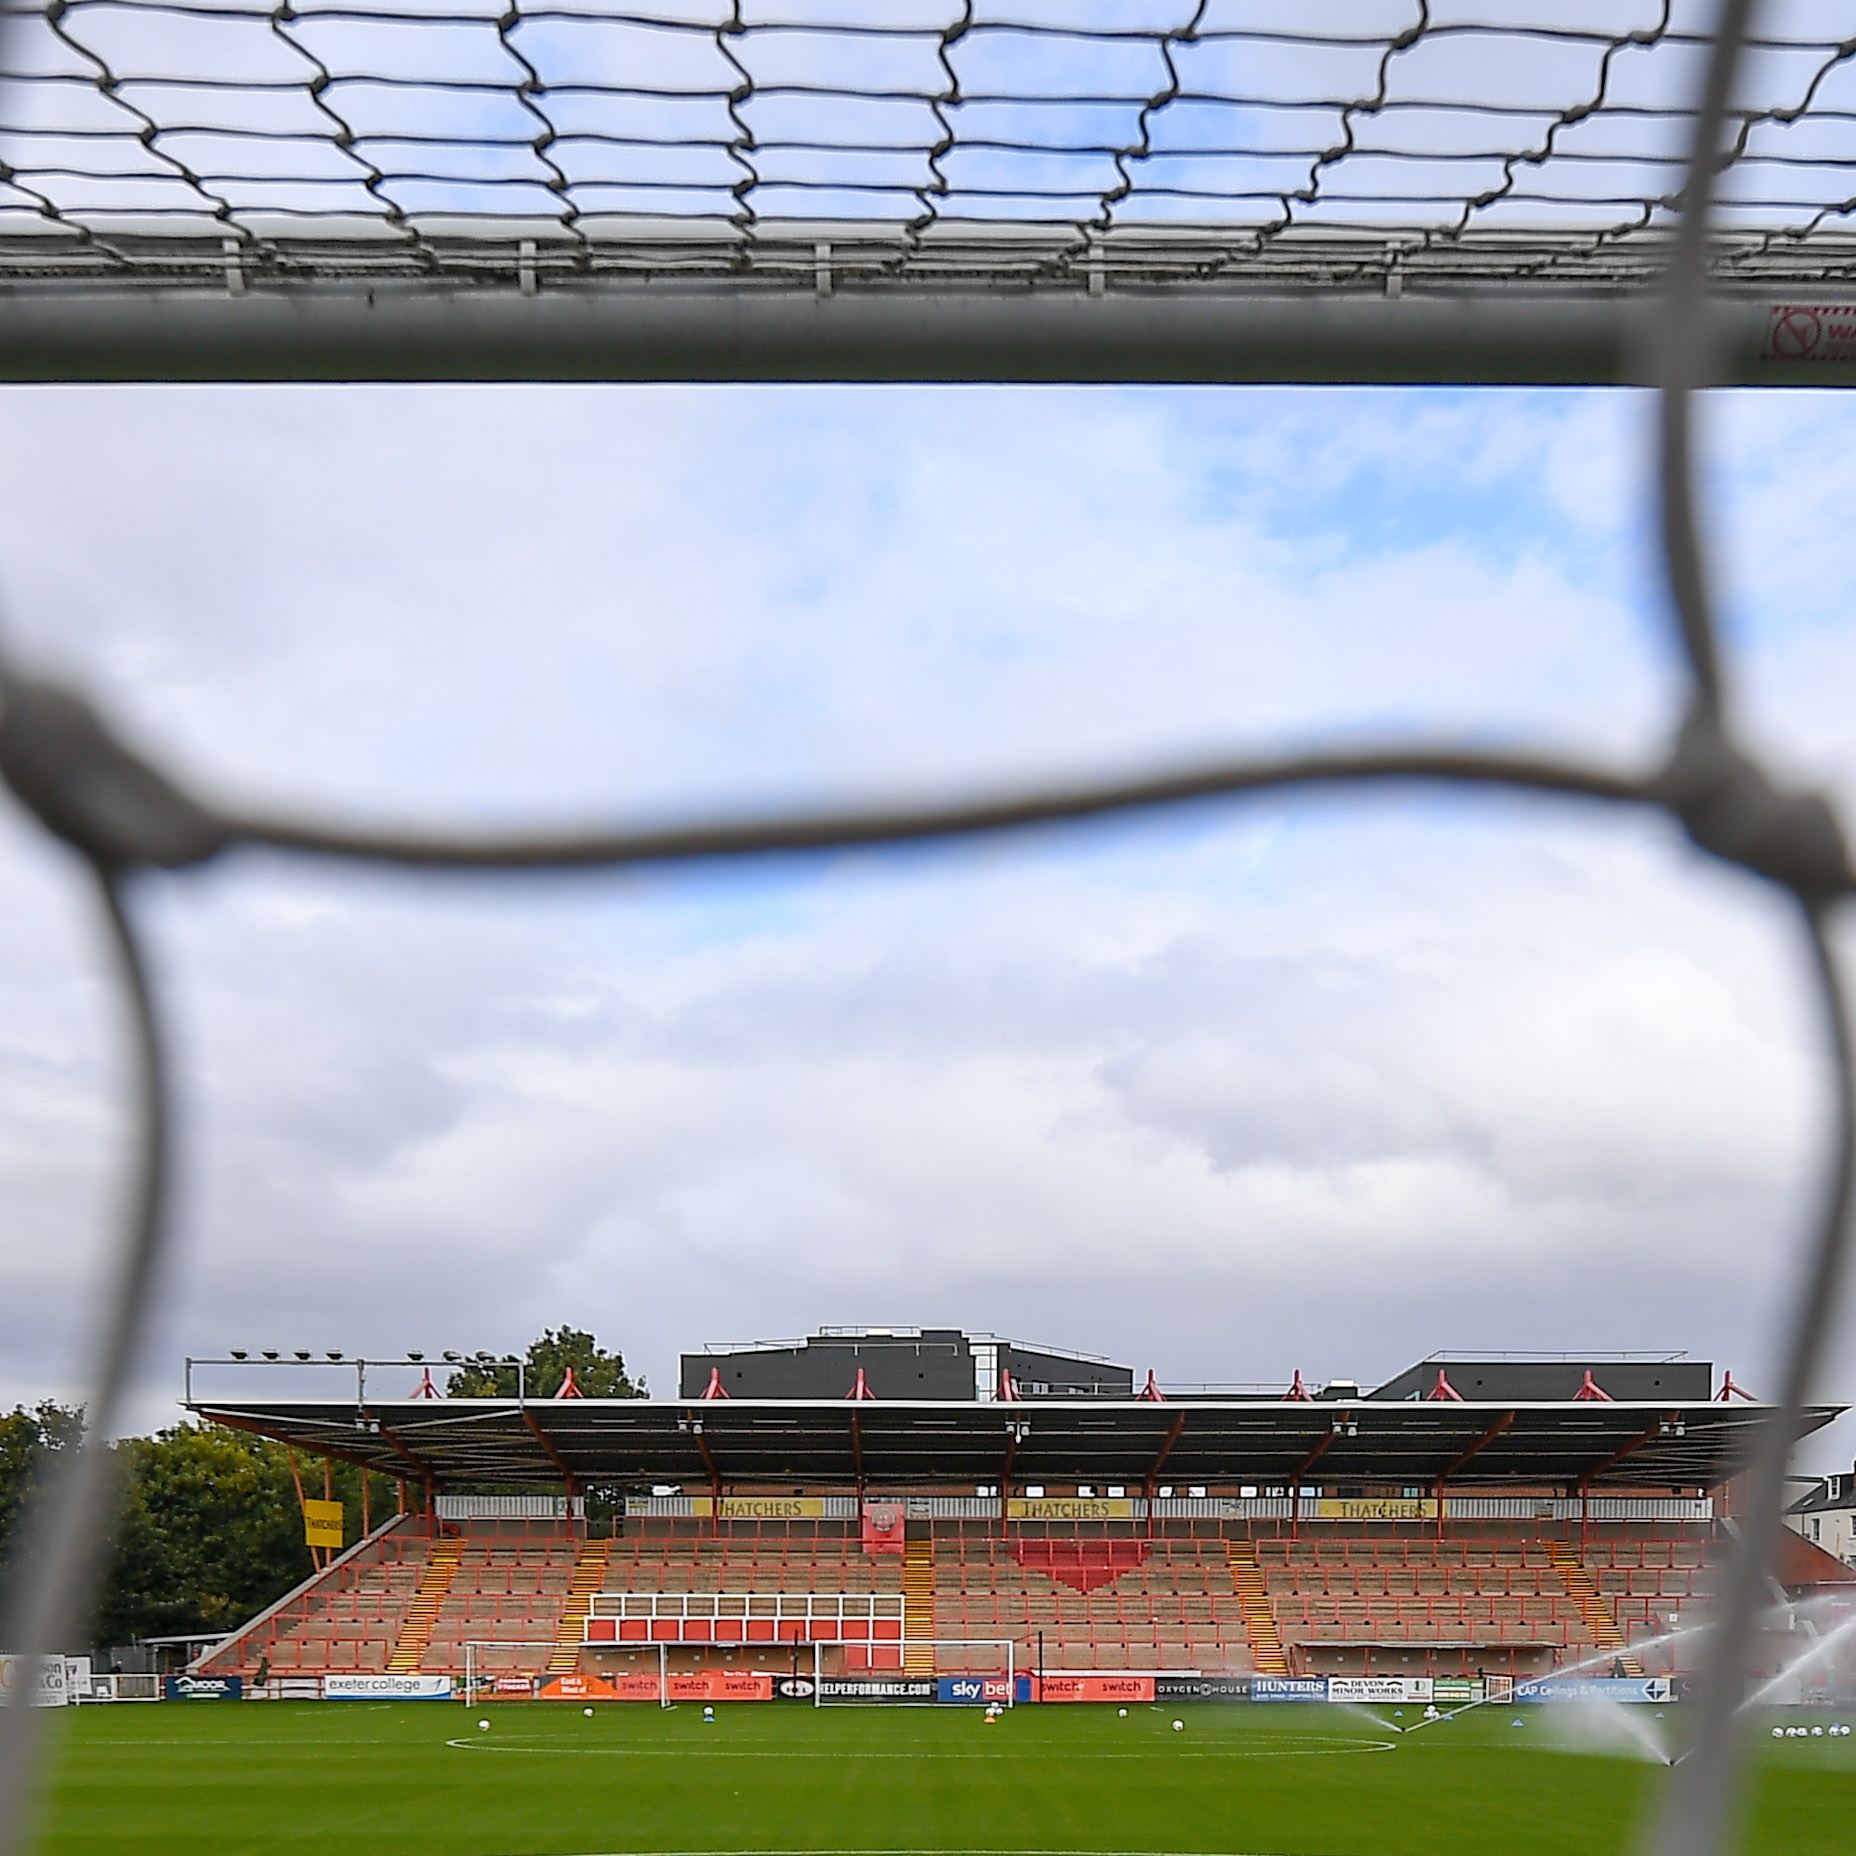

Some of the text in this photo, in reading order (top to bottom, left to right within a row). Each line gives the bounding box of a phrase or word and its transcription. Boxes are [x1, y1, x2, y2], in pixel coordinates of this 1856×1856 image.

[720, 1500, 802, 1516] HATCHERS
[1022, 1501, 1110, 1518] THATCHERS
[1340, 1501, 1428, 1518] THATCHERS
[329, 1678, 421, 1693] exeter college
[622, 1678, 657, 1690] switch
[674, 1677, 710, 1690] switch
[725, 1677, 761, 1690] switch
[952, 1680, 981, 1699] sky
[1041, 1680, 1080, 1692] switch
[1102, 1680, 1141, 1692] switch
[1157, 1685, 1248, 1693] OXYGEN HOUSE
[1256, 1681, 1325, 1692] HUNTERS
[1517, 1685, 1638, 1698] CAP Ceilings & Partitions
